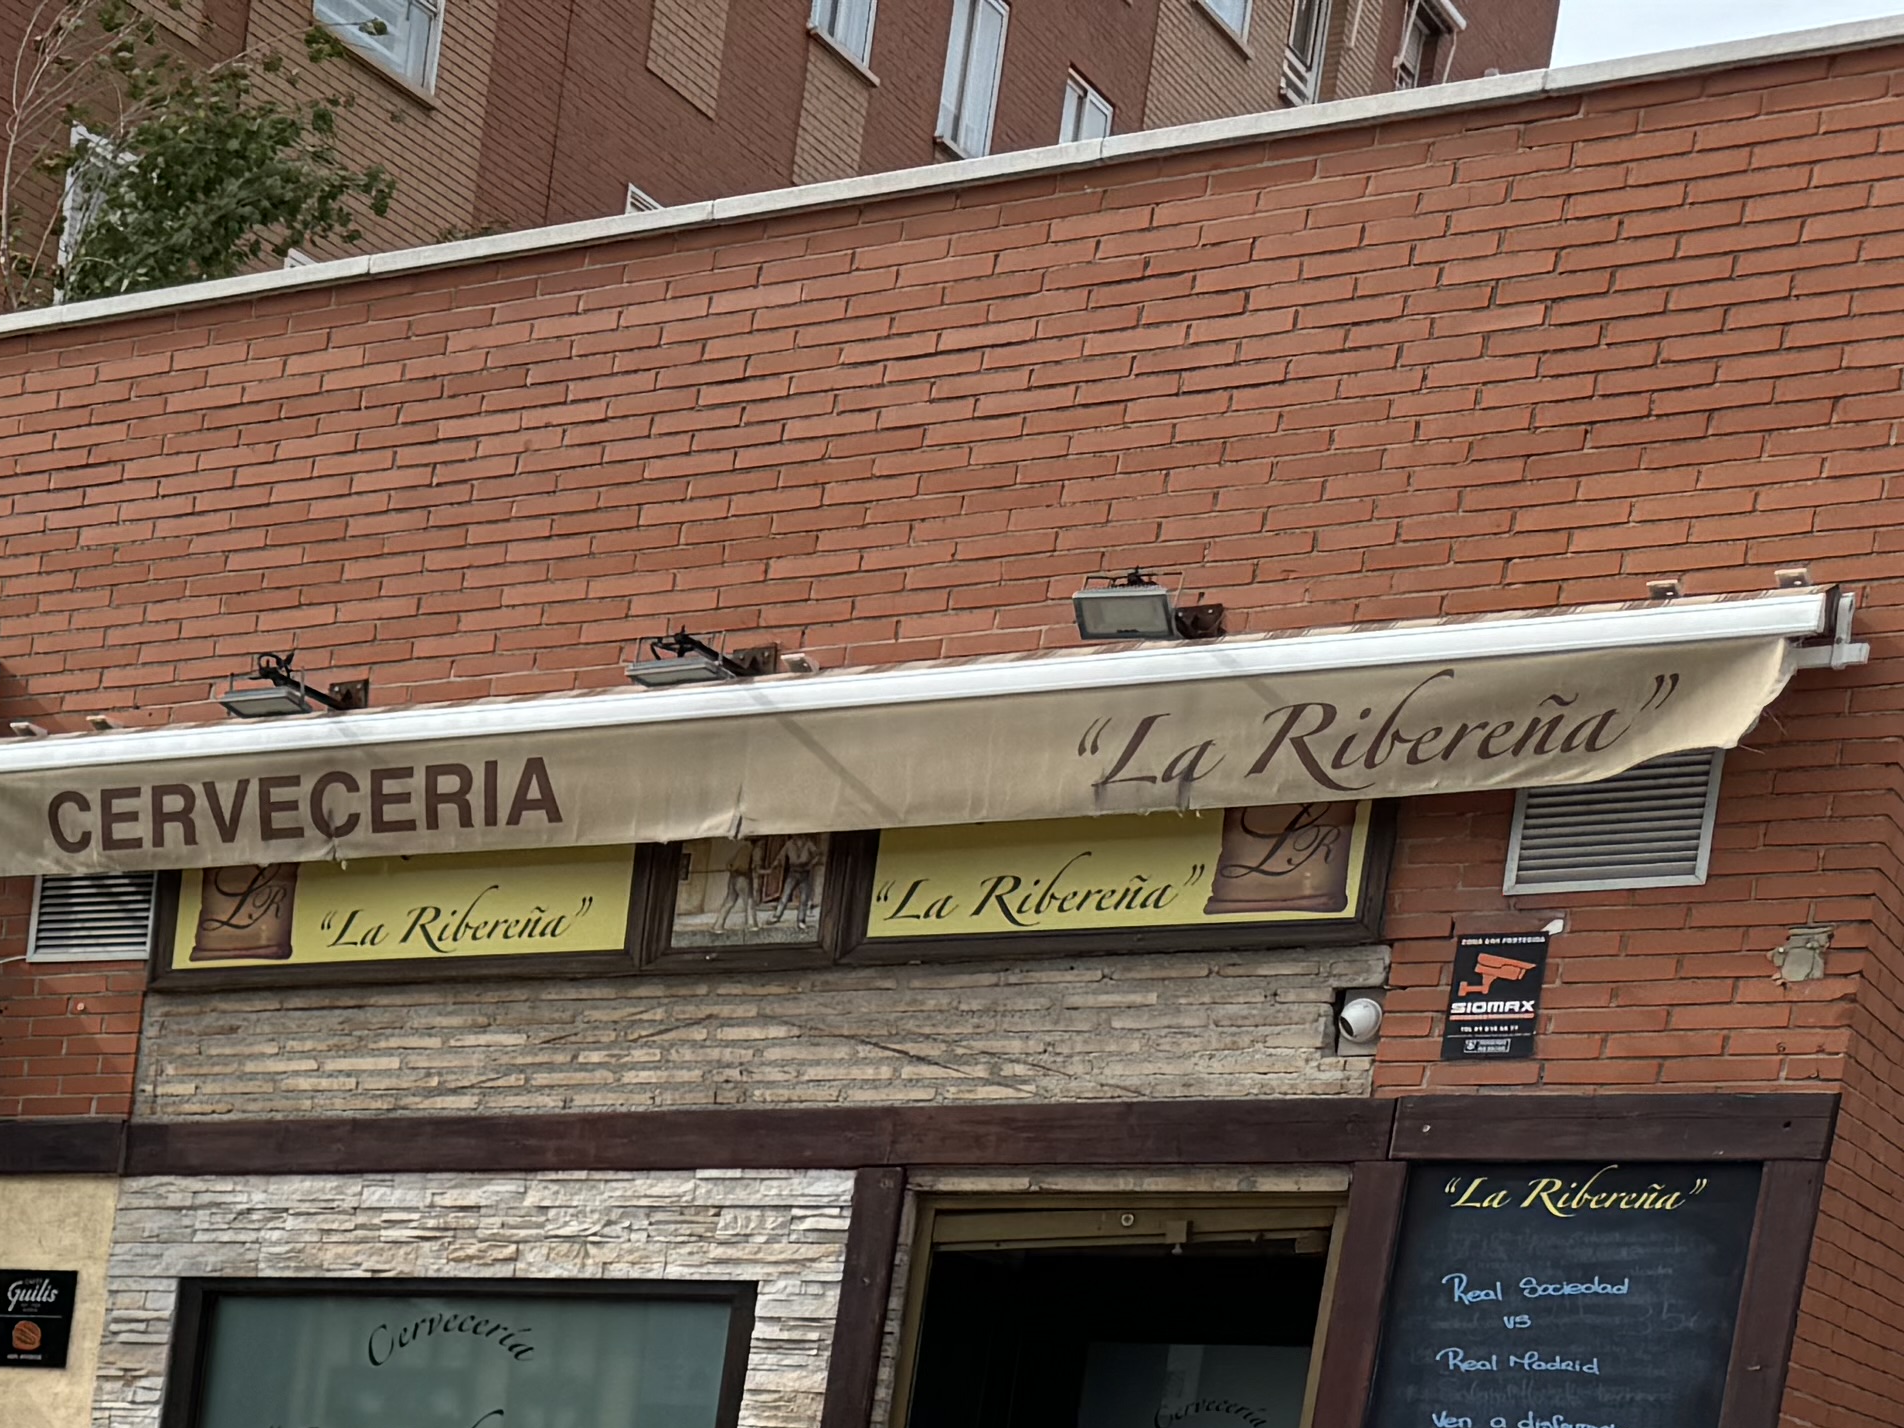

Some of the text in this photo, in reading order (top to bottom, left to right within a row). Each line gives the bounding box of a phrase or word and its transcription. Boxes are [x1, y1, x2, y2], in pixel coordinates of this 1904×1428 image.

[48, 756, 565, 855] CERVECERIA
[1450, 1000, 1535, 1014] SIOMAX
[7, 1278, 59, 1312] Guilis
[1441, 1272, 1630, 1305] Real Sociedad
[366, 1308, 536, 1367] Cervecería
[1435, 1347, 1601, 1376] Real Madrid
[1490, 1415, 1507, 1428] a
